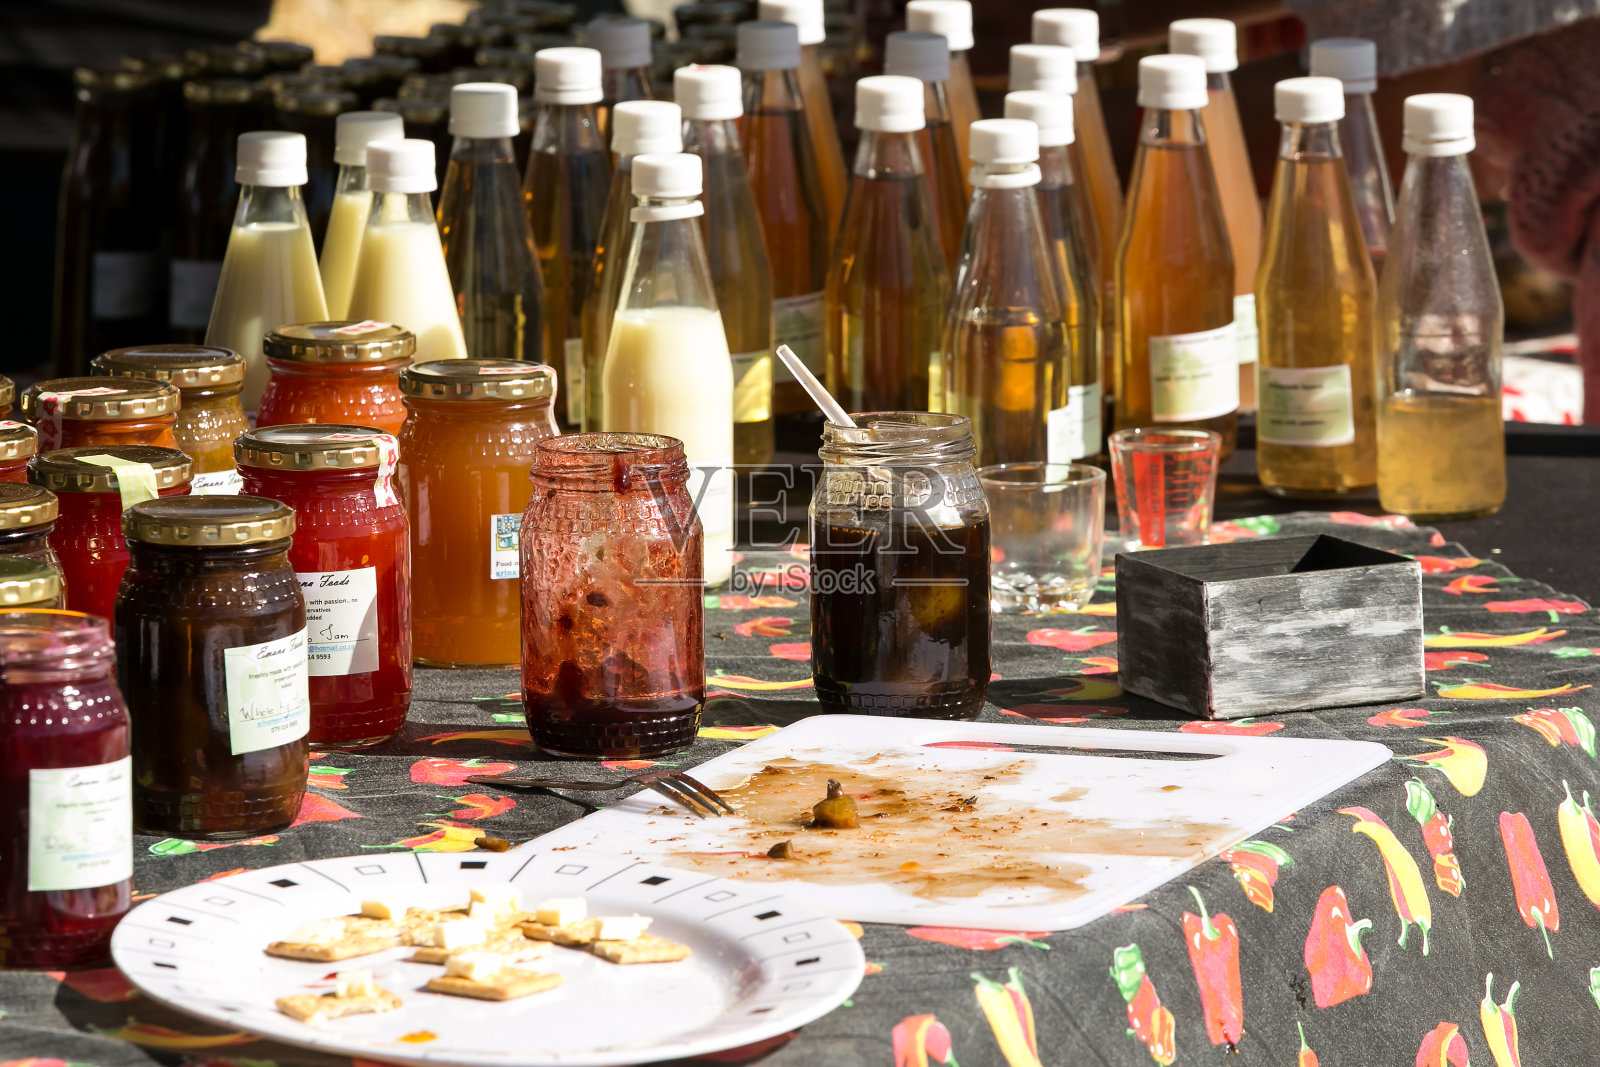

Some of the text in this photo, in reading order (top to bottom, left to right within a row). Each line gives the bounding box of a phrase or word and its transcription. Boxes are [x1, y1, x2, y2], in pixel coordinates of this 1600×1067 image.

[319, 574, 350, 588] Foods
[319, 623, 349, 641] Jam
[308, 644, 355, 653] @hotmail.co.za
